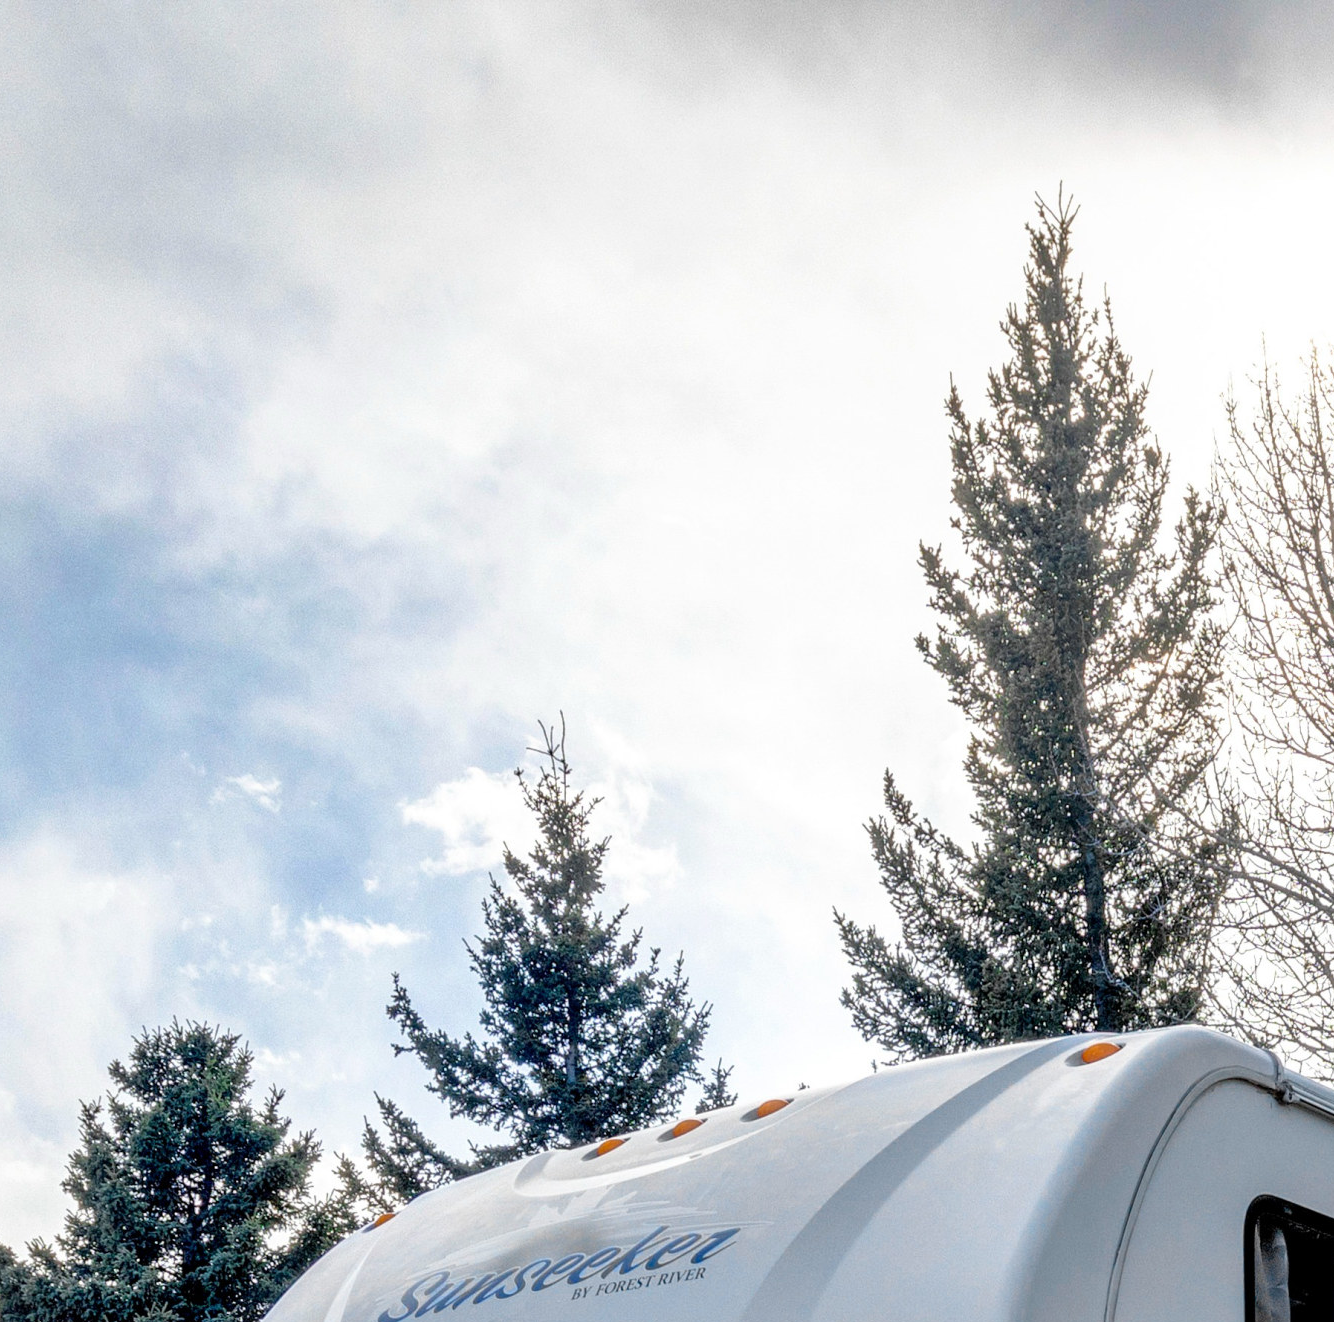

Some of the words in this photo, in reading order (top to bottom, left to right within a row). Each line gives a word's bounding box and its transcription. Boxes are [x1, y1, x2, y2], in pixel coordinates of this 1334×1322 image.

[571, 1285, 592, 1300] BY
[595, 1275, 655, 1296] FOREST
[657, 1267, 706, 1286] RIVER
